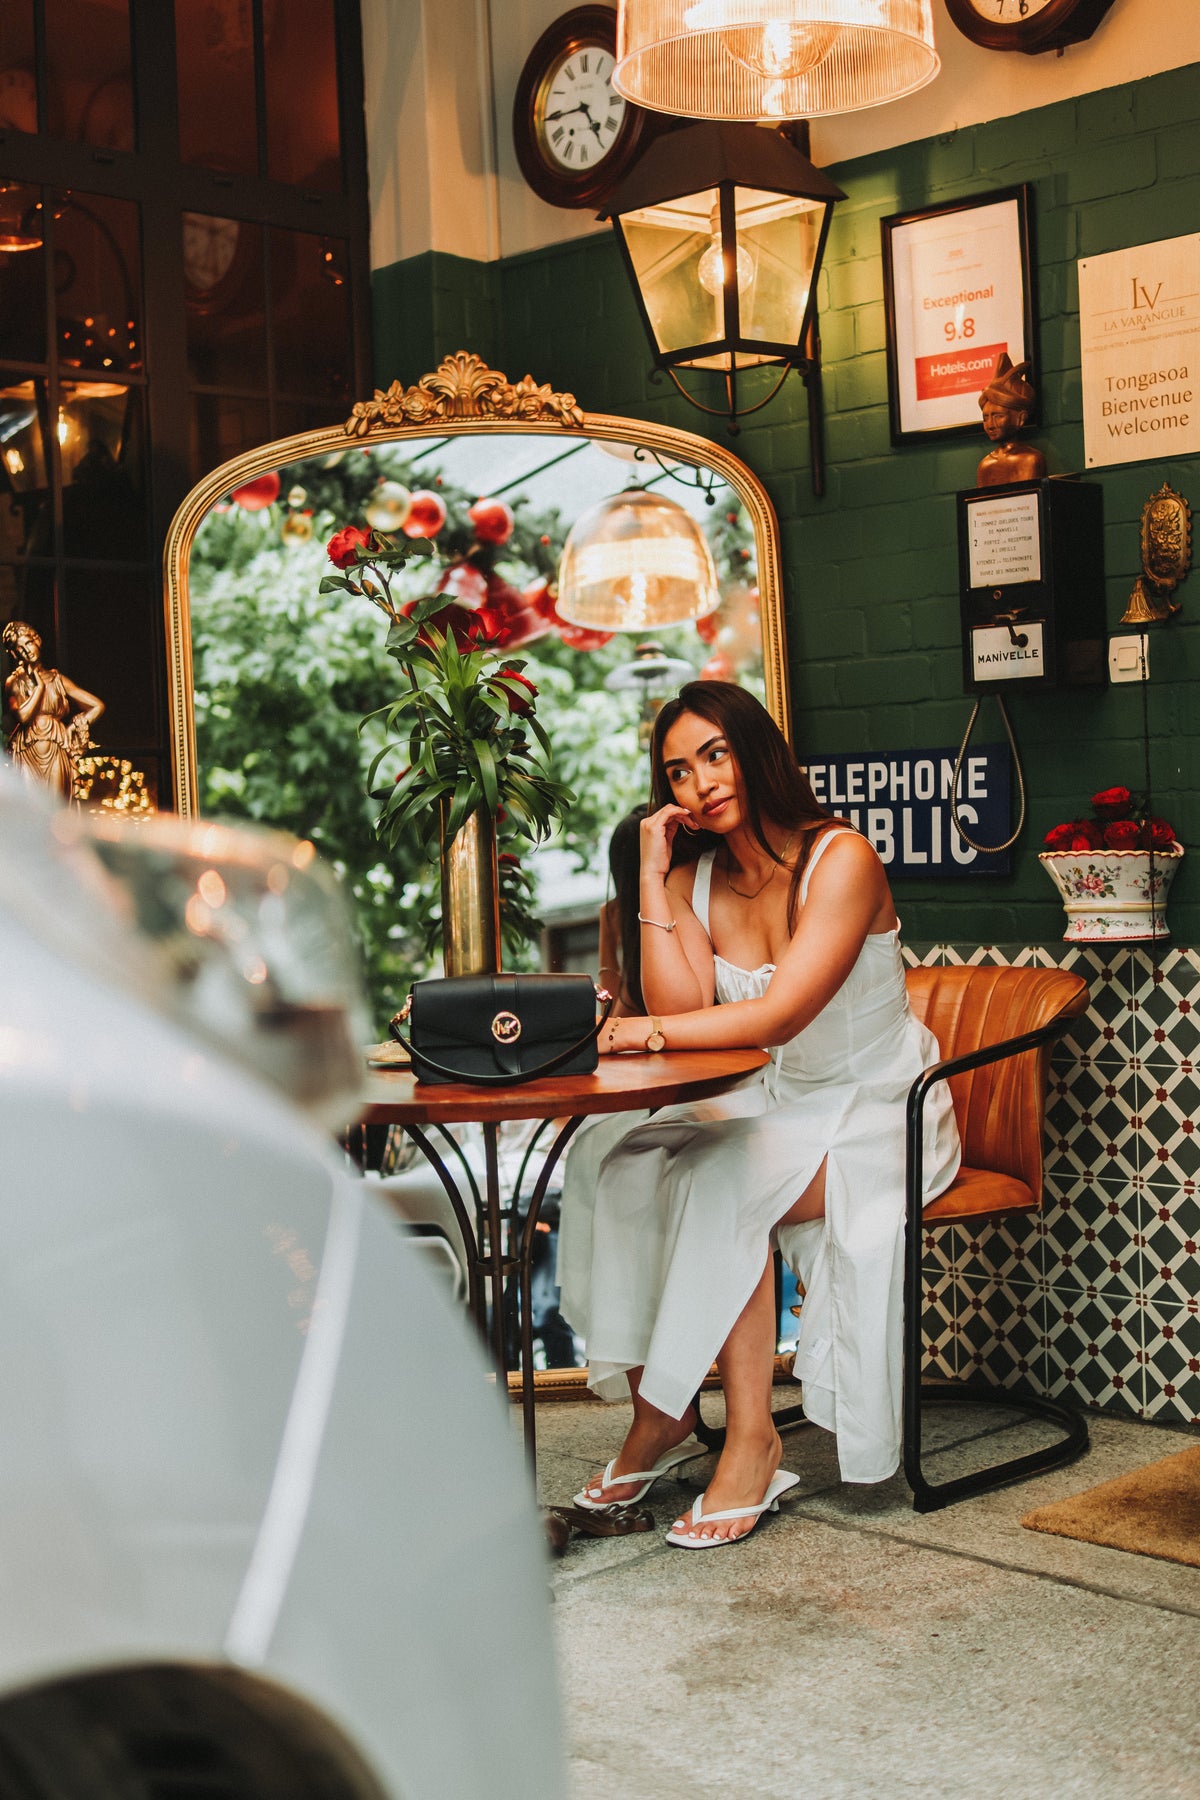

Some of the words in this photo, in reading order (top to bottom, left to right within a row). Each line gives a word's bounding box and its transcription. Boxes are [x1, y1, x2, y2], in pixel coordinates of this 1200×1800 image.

[923, 285, 994, 310] Exceptional
[1131, 277, 1164, 310] LV
[944, 318, 975, 342] 9.8
[1104, 320, 1118, 331] LA
[1120, 306, 1187, 328] VARANGUE
[930, 357, 993, 377] Hotels.com
[1104, 366, 1189, 393] Tongasoa
[1102, 390, 1193, 417] Bienvenue
[1107, 413, 1190, 438] Welcome
[973, 539, 978, 547] 2
[799, 756, 988, 804] ELEPHONE
[834, 803, 979, 866] BLIC
